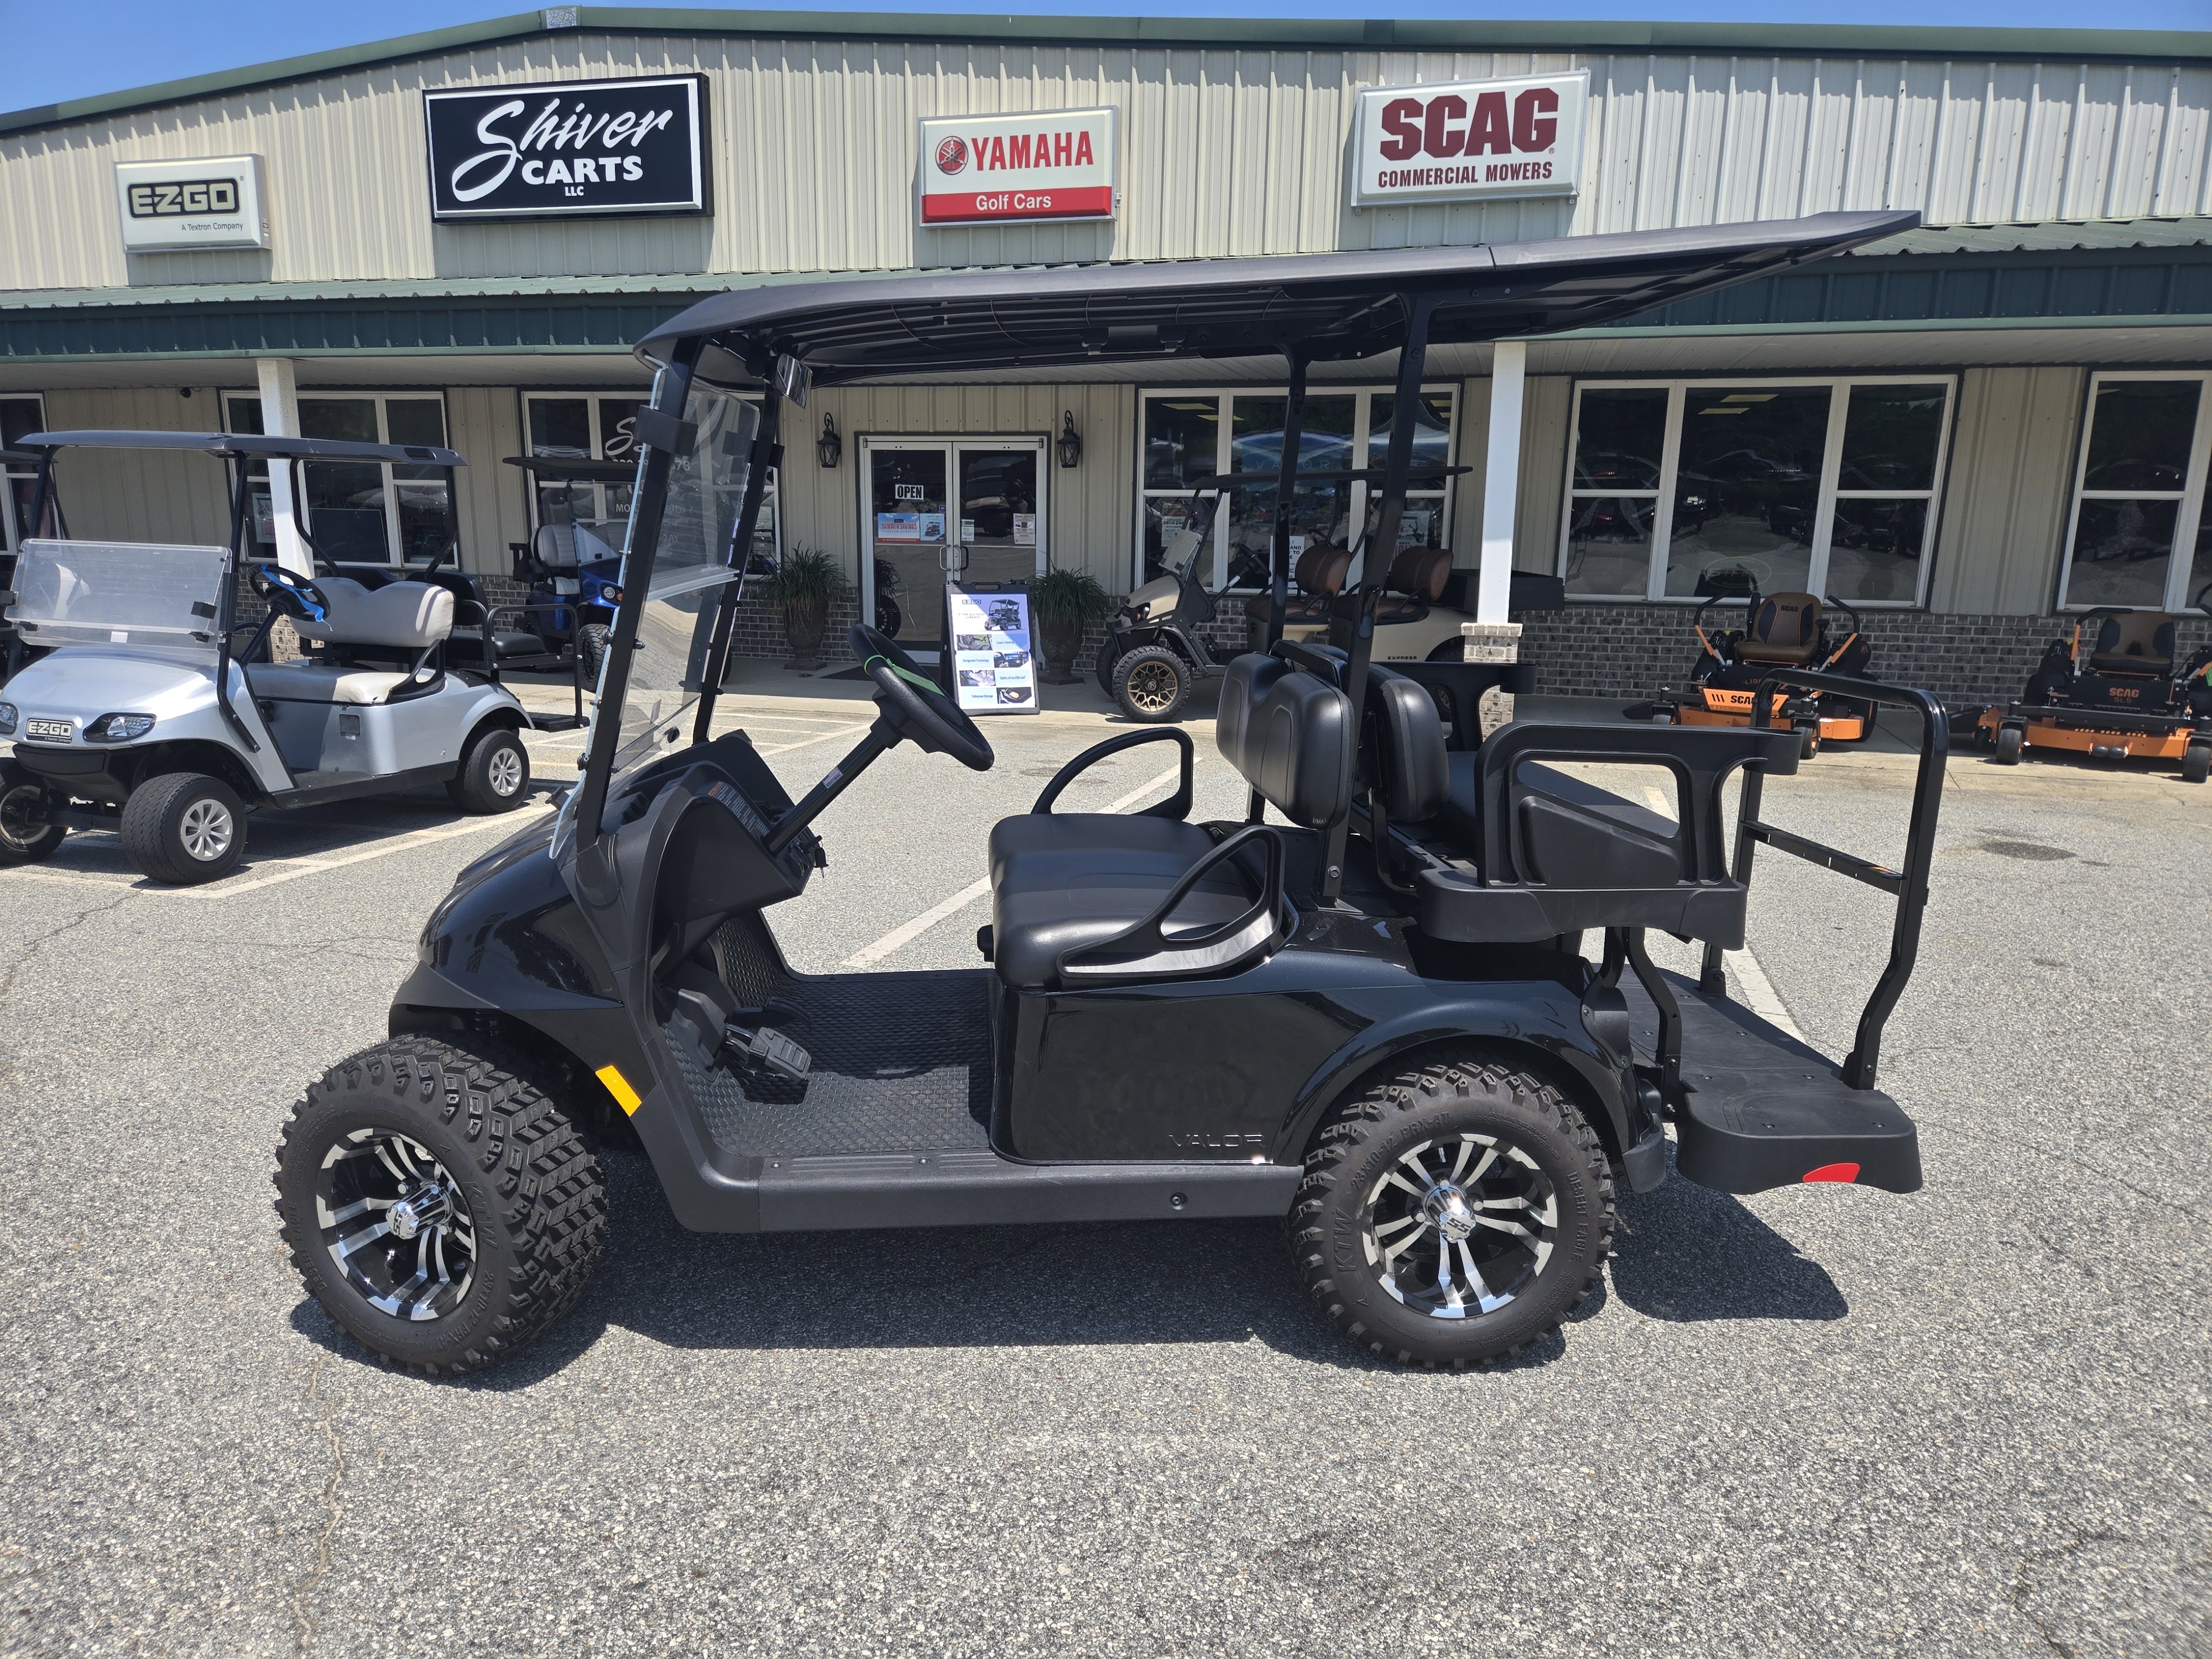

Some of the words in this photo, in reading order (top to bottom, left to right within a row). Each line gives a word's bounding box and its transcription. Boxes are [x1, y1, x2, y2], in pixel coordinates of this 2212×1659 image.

[1379, 87, 1559, 161] SCAG
[451, 98, 673, 202] Shiver
[971, 131, 1094, 171] YAMAHA
[521, 155, 644, 185] CARTS
[1378, 165, 1479, 188] COMMERCIAL
[1485, 161, 1553, 182] MOWERS
[131, 181, 236, 215] EZGO
[564, 186, 585, 196] LLC
[976, 194, 1009, 211] Golf
[1014, 193, 1052, 209] Cars
[187, 222, 211, 231] Textron
[213, 221, 244, 232] Company
[1256, 460, 1329, 469] VAOR
[897, 486, 922, 498] OPEN
[2109, 687, 2140, 698] SCAG
[28, 722, 72, 736] EZGO
[1168, 1134, 1266, 1149] VALOR
[461, 1181, 499, 1249] KTW
[1332, 1206, 1357, 1272] KTW
